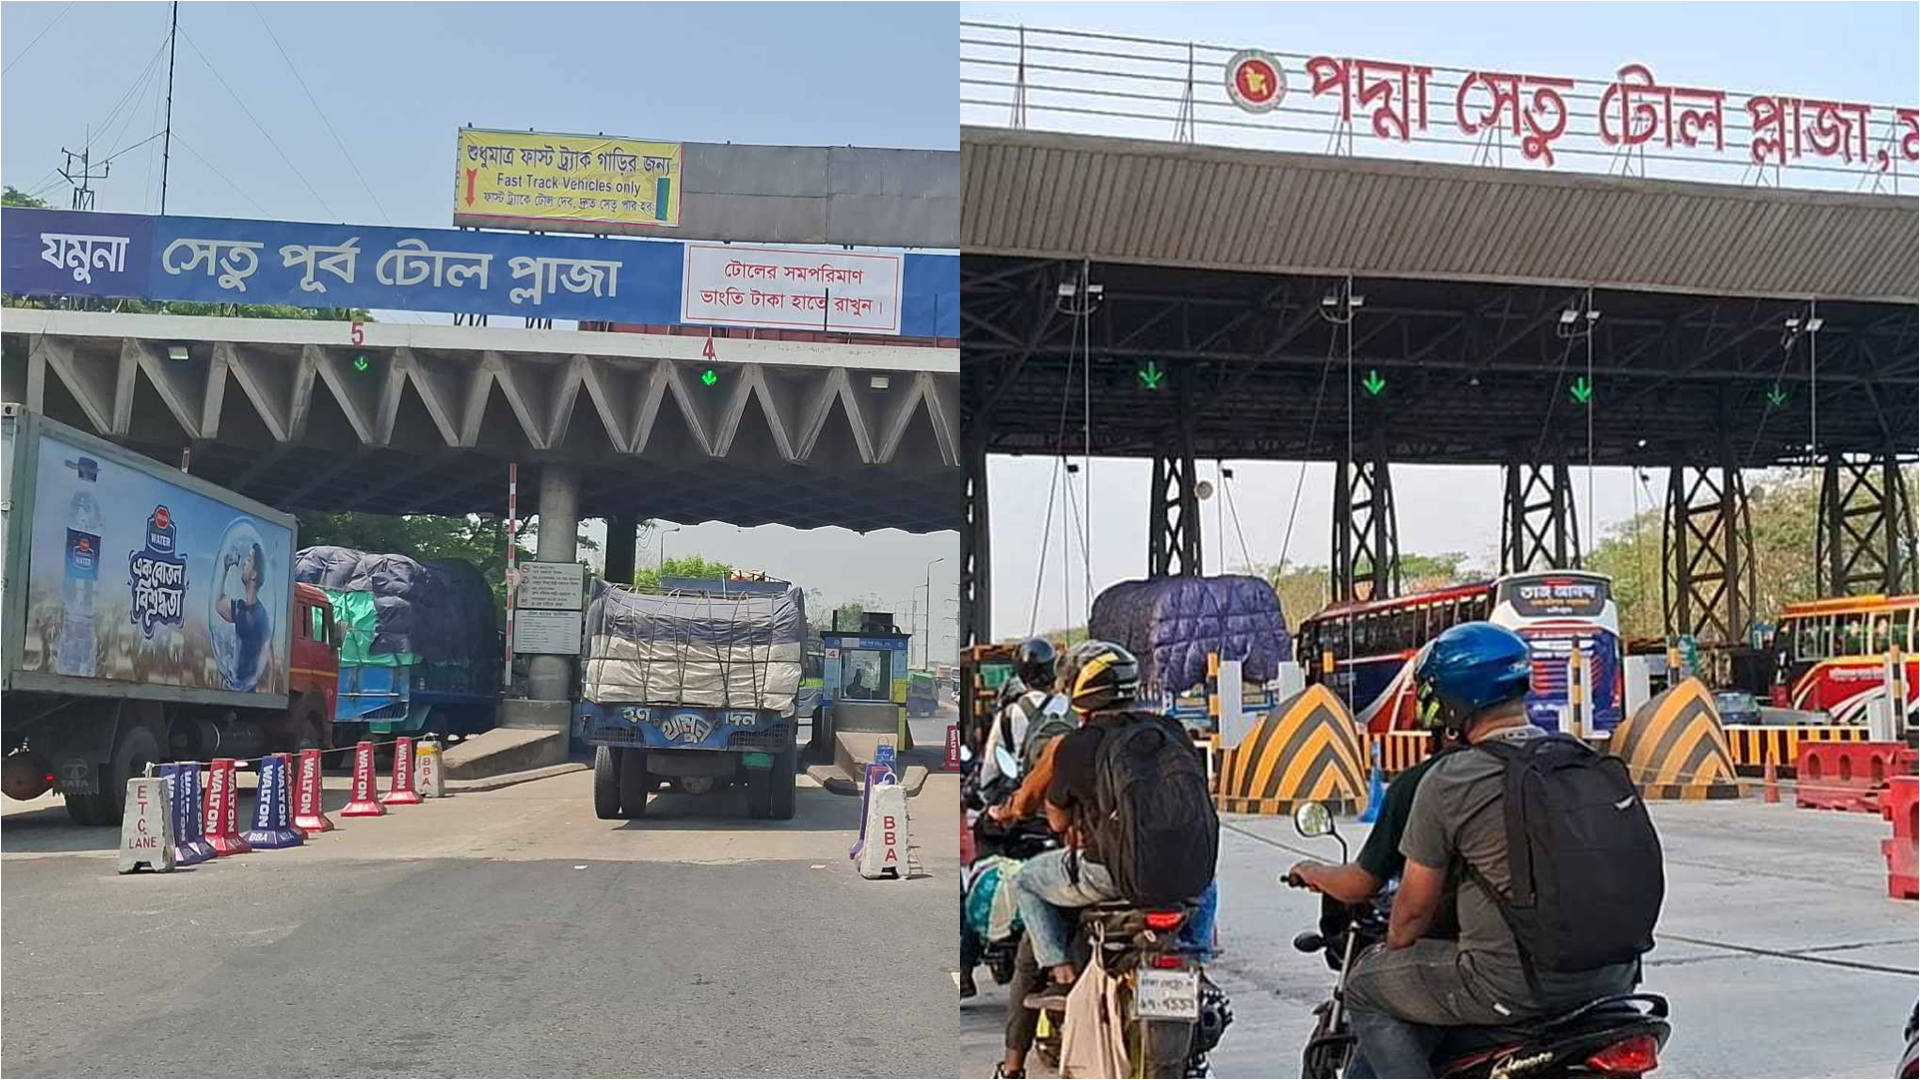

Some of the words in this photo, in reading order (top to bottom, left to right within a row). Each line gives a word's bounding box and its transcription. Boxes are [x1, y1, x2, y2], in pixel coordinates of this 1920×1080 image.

[1306, 56, 1433, 142] পদ্মা
[1456, 71, 1576, 167] সেতু
[1599, 64, 1727, 152] টোল
[467, 144, 515, 169] শুধুমাত্র
[519, 144, 555, 168] ফাস্ট
[597, 147, 640, 175] গাড়ির
[643, 155, 673, 176] জন্য
[497, 173, 522, 188] Fast
[527, 174, 558, 189] Track
[563, 177, 611, 192] Vehicles
[616, 181, 641, 197] only
[40, 232, 130, 285] যমুনা
[162, 238, 265, 293] সেতু
[278, 236, 361, 294] পূর্ব
[376, 238, 494, 290] টোল
[507, 256, 623, 305] প্লাজা
[724, 259, 779, 280] টোলের
[784, 263, 865, 285] সমপরিমাণ
[700, 287, 745, 307] ভাংতি
[749, 287, 786, 309] টাকা
[791, 293, 828, 312] হাতে
[834, 297, 874, 317] রাখুন
[351, 322, 364, 346] 5
[702, 337, 716, 361] 4
[150, 532, 171, 548] WATER
[300, 757, 315, 814] WALTON
[357, 749, 369, 801] WALTON
[397, 743, 408, 790] WALTON
[195, 769, 203, 836] WALTON
[205, 768, 224, 834] WALTON
[227, 768, 236, 833] WALTON
[258, 764, 274, 828] WALTON
[277, 764, 287, 827] WALTON
[128, 837, 158, 850] LANE
[884, 816, 898, 862] BBA
